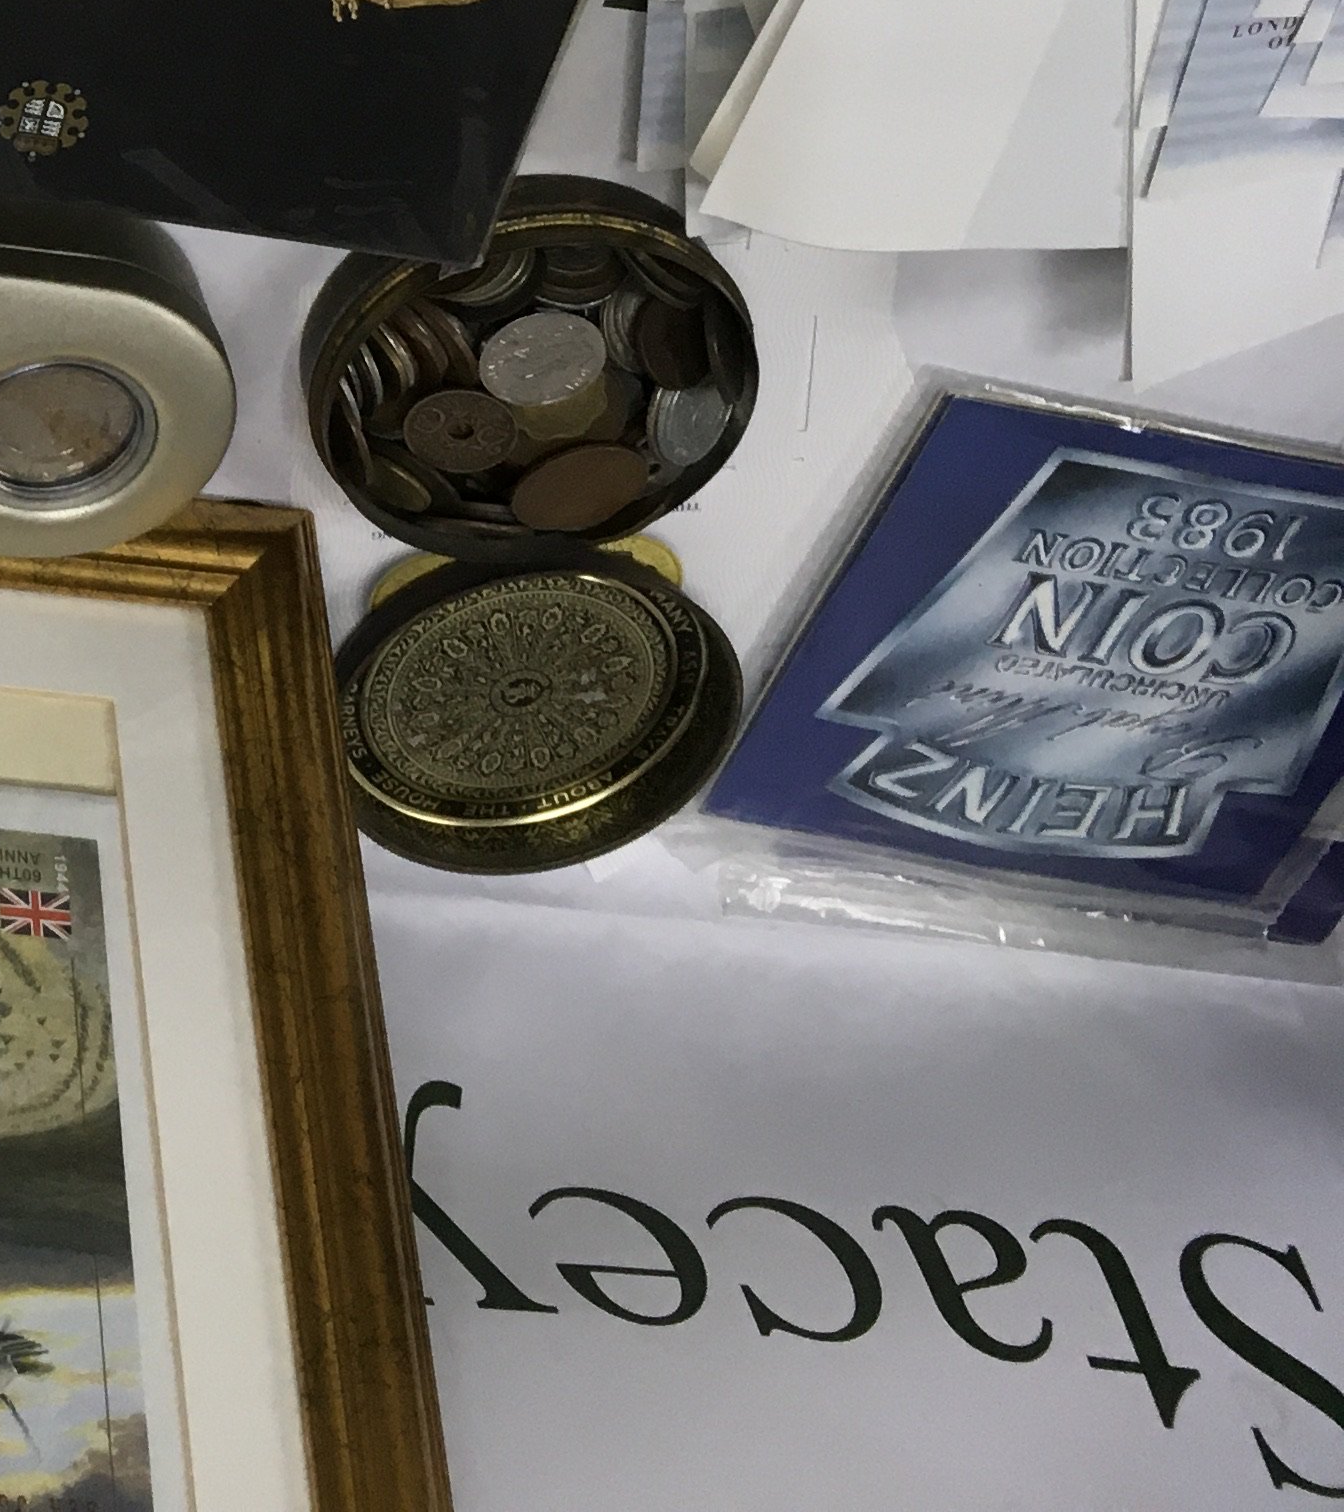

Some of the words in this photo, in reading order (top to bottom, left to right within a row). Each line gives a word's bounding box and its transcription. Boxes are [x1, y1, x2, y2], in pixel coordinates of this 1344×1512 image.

[1126, 493, 1307, 560] 1983
[1012, 529, 1343, 613] COLLECTION
[985, 571, 1296, 685] COIN
[996, 654, 1230, 708] UNCIRCULATED
[372, 771, 441, 809] HOUSE
[536, 771, 613, 809] ABOUT
[867, 738, 1190, 841] HEINZ
